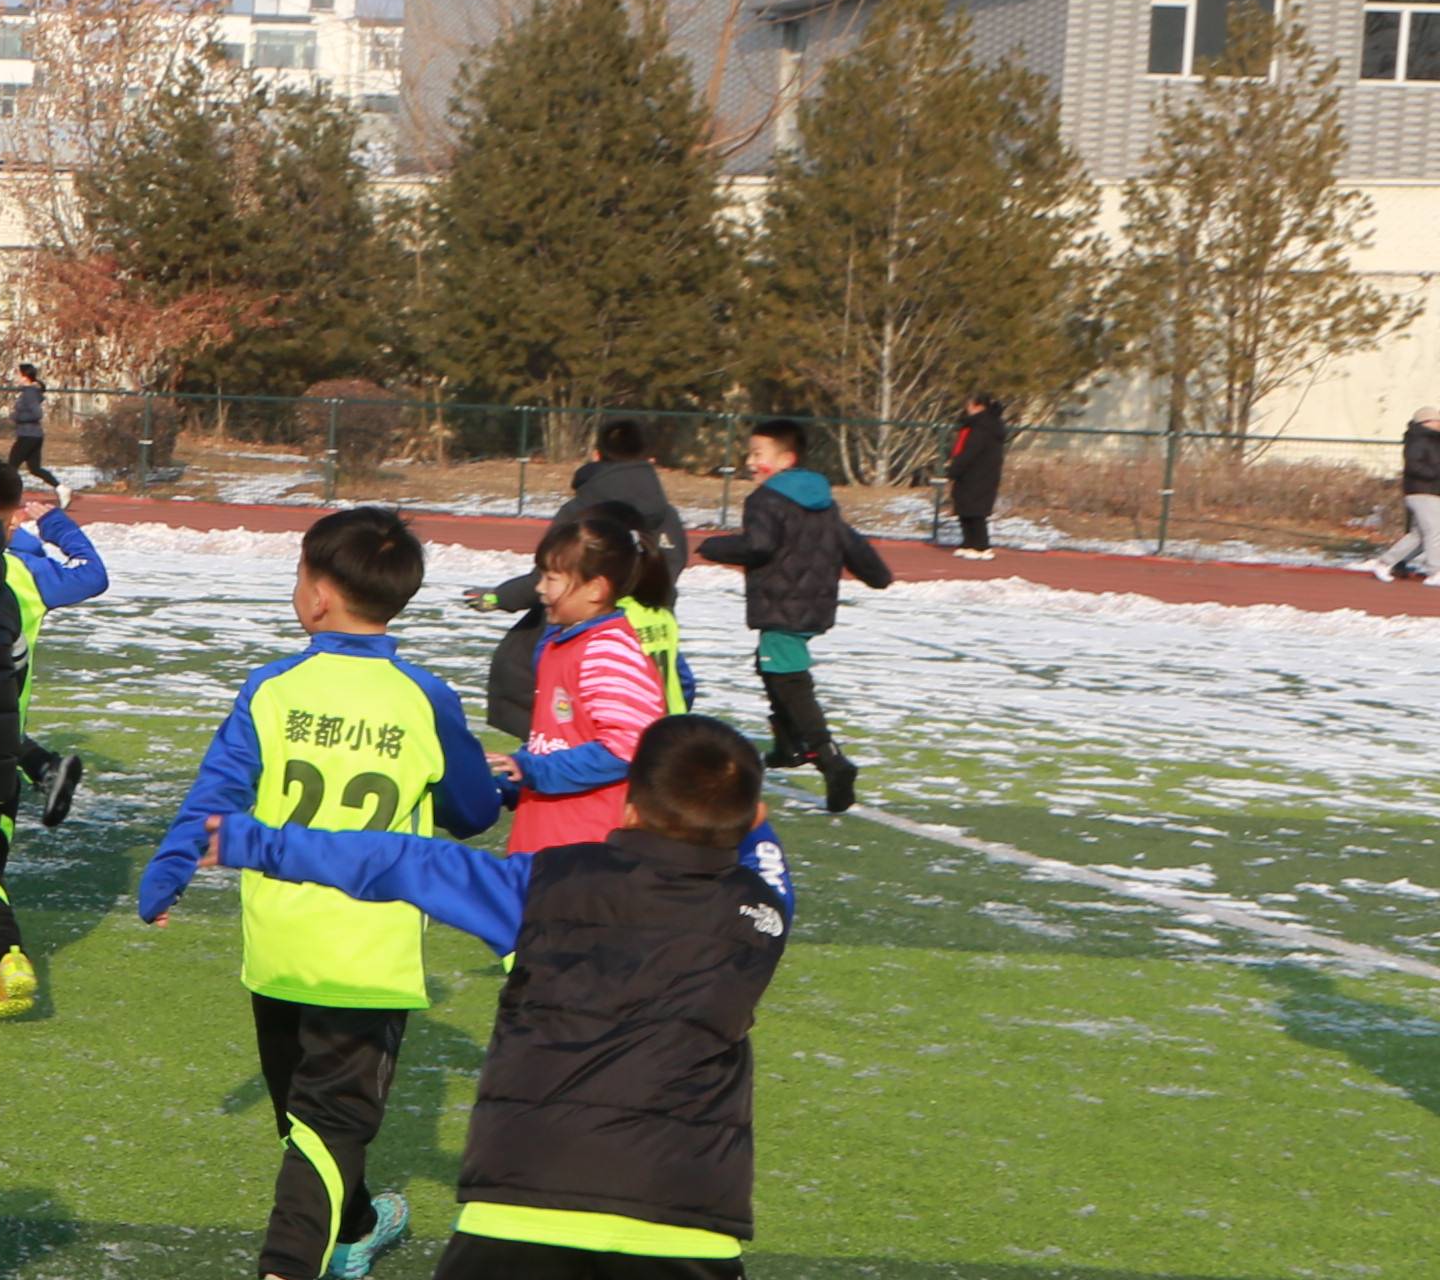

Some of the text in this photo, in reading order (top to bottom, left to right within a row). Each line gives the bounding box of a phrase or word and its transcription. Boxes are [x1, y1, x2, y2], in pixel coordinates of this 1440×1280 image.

[285, 709, 405, 759] 黎都小将
[282, 759, 400, 832] 22
